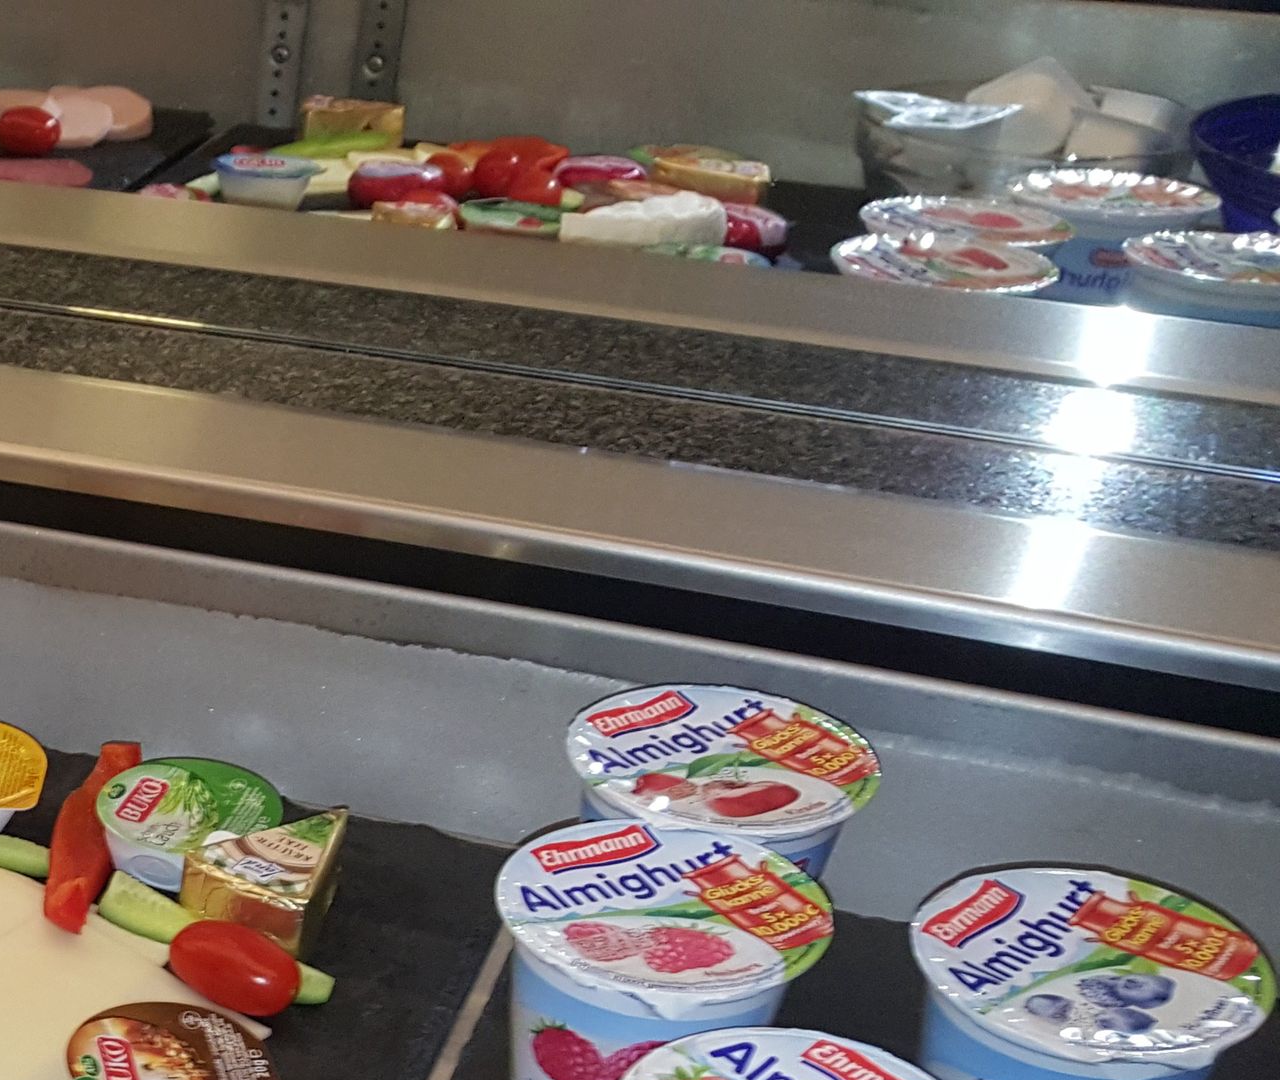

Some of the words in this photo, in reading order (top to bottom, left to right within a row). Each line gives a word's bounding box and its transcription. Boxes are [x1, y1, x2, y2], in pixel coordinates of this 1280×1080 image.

[587, 698, 764, 774] Almighurt
[592, 694, 685, 733] Ehrmann
[118, 777, 165, 822] BUKO
[519, 840, 734, 913] Almighurt
[538, 829, 646, 868] Ehrmann
[932, 885, 1011, 942] Ehrmann
[948, 878, 1097, 993] Almighurt
